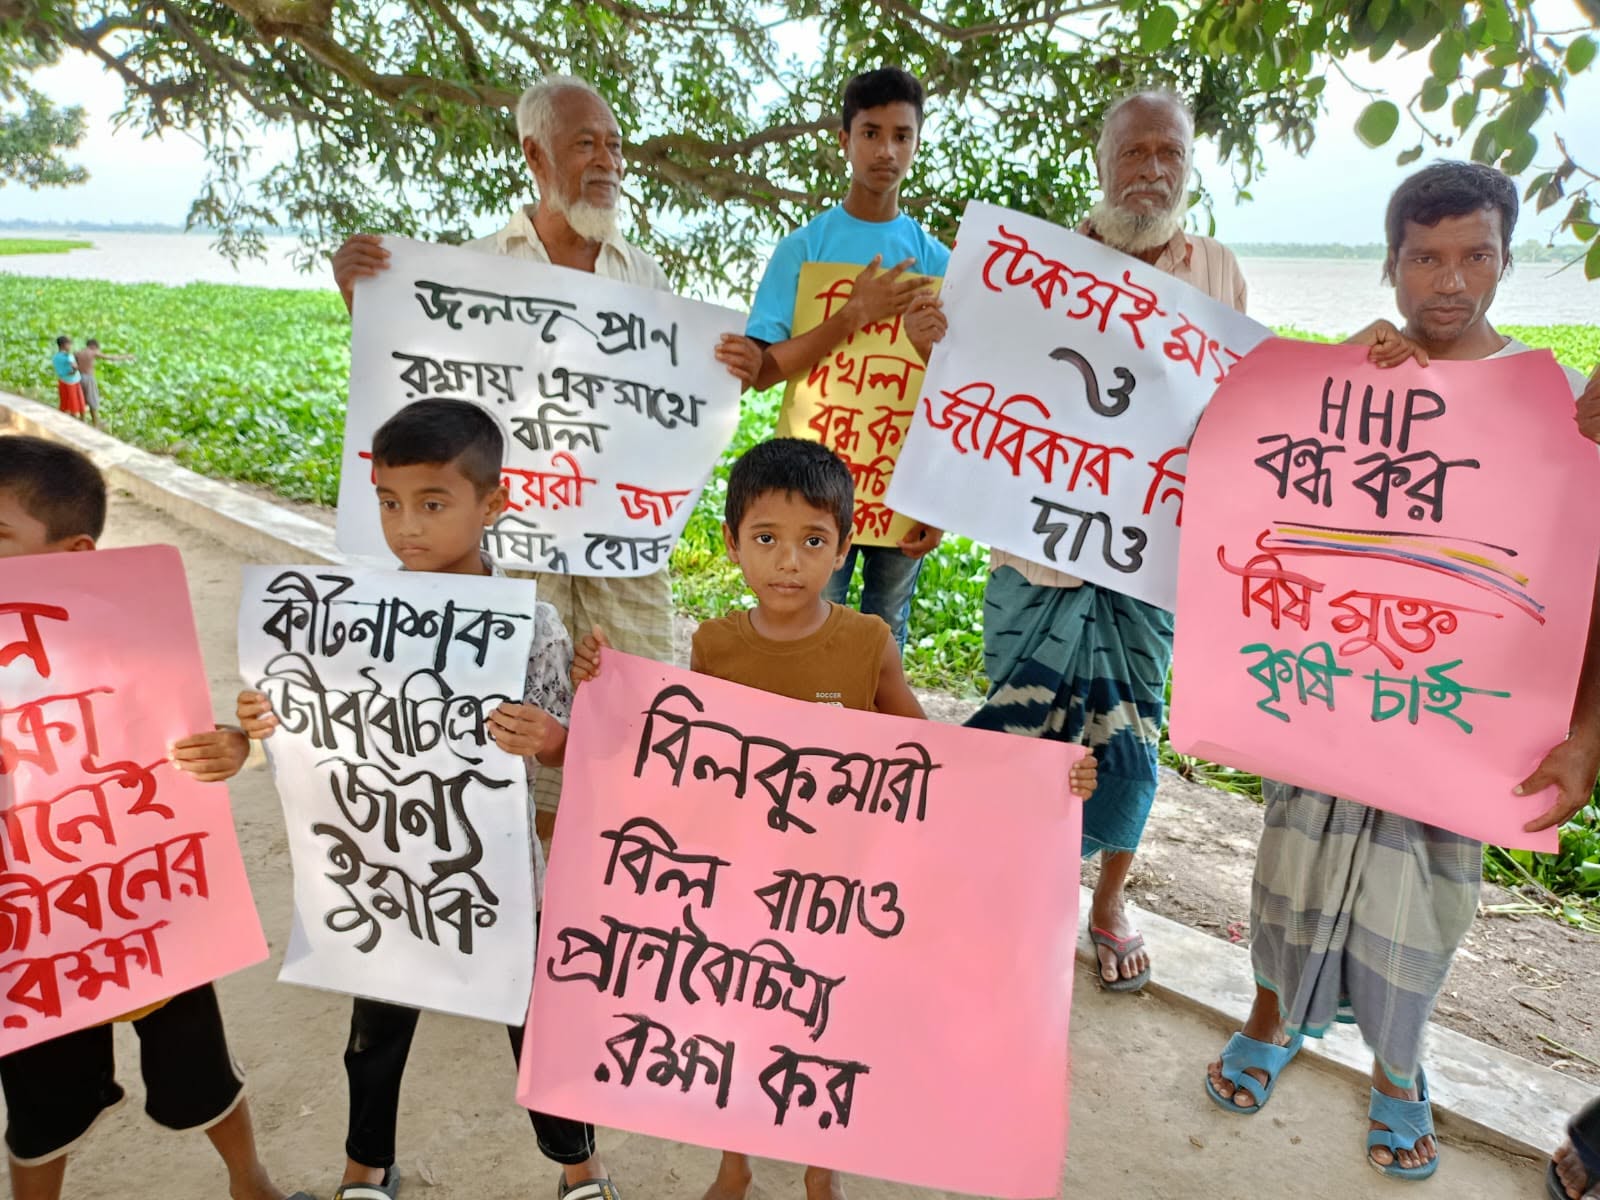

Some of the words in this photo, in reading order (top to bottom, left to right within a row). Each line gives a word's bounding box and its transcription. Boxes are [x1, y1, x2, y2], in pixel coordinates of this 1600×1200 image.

[414, 280, 577, 343] জলজ
[982, 224, 1167, 349] টেকসই
[392, 352, 523, 404] রক্ষায়
[1048, 347, 1136, 417] ও
[1319, 376, 1447, 454] HHP
[510, 403, 610, 453] বলি
[923, 382, 1134, 497] জীবিকার
[1254, 434, 1346, 507] বন্ধ
[1352, 450, 1481, 523] কর
[1030, 496, 1148, 574] দাও
[262, 571, 531, 673] কীটনাশক
[1217, 544, 1327, 631] বিষ
[1329, 588, 1506, 671] মুক্ত
[1239, 641, 1353, 723] কৃষি
[1363, 659, 1512, 735] চাই
[312, 822, 499, 955] হুমকি
[600, 816, 731, 909] বিল
[0, 919, 171, 1029] রক্ষা
[594, 1013, 735, 1109] রক্ষা
[759, 1044, 871, 1130] কর
